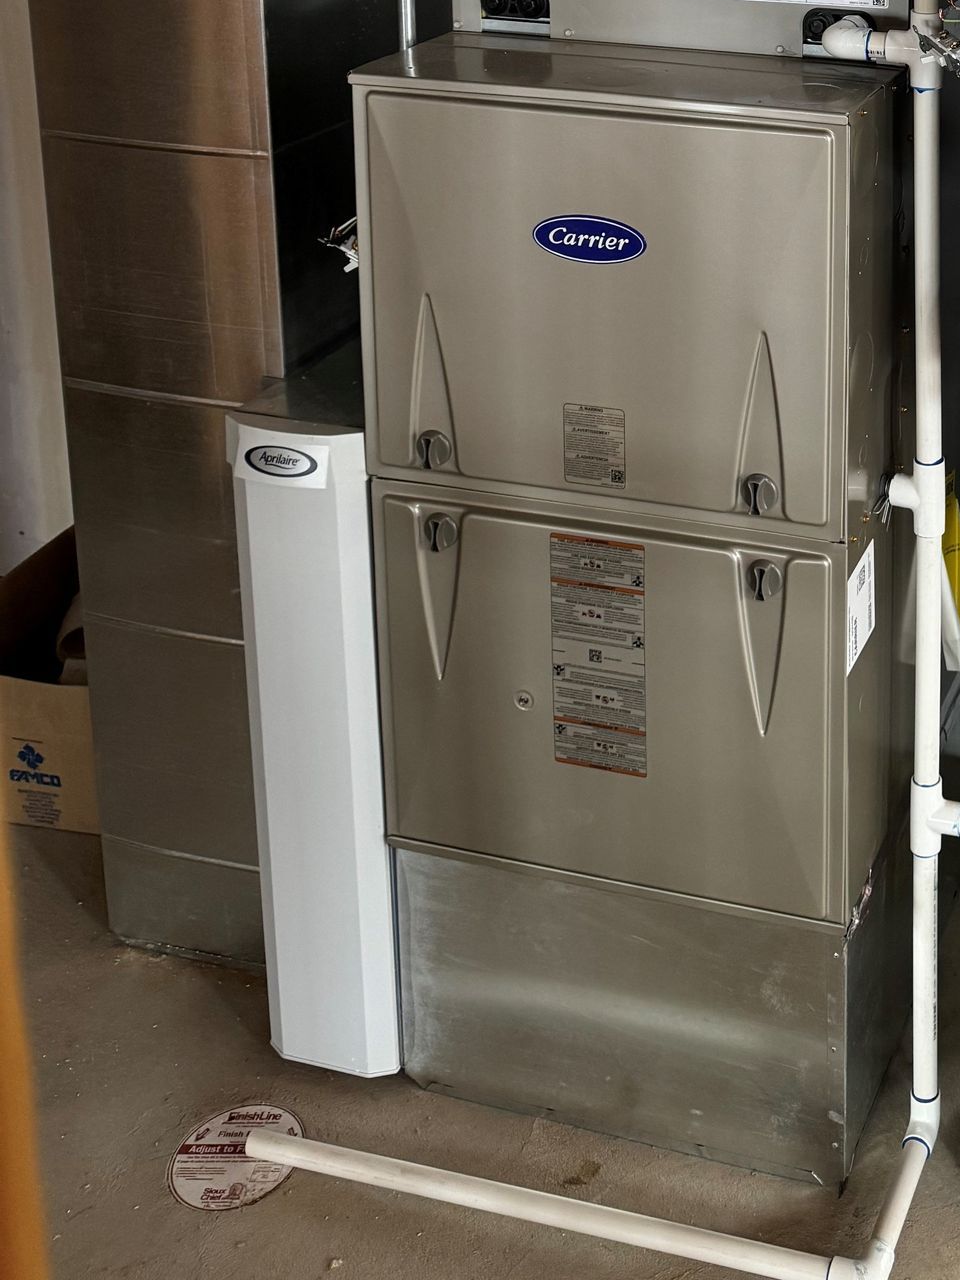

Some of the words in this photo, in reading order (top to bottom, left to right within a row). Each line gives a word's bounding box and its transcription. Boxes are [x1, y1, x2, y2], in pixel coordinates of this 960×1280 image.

[549, 227, 629, 251] Carrier
[259, 451, 300, 468] Aprilaire
[228, 1112, 282, 1121] FinishLine
[189, 1145, 221, 1153] Adjust
